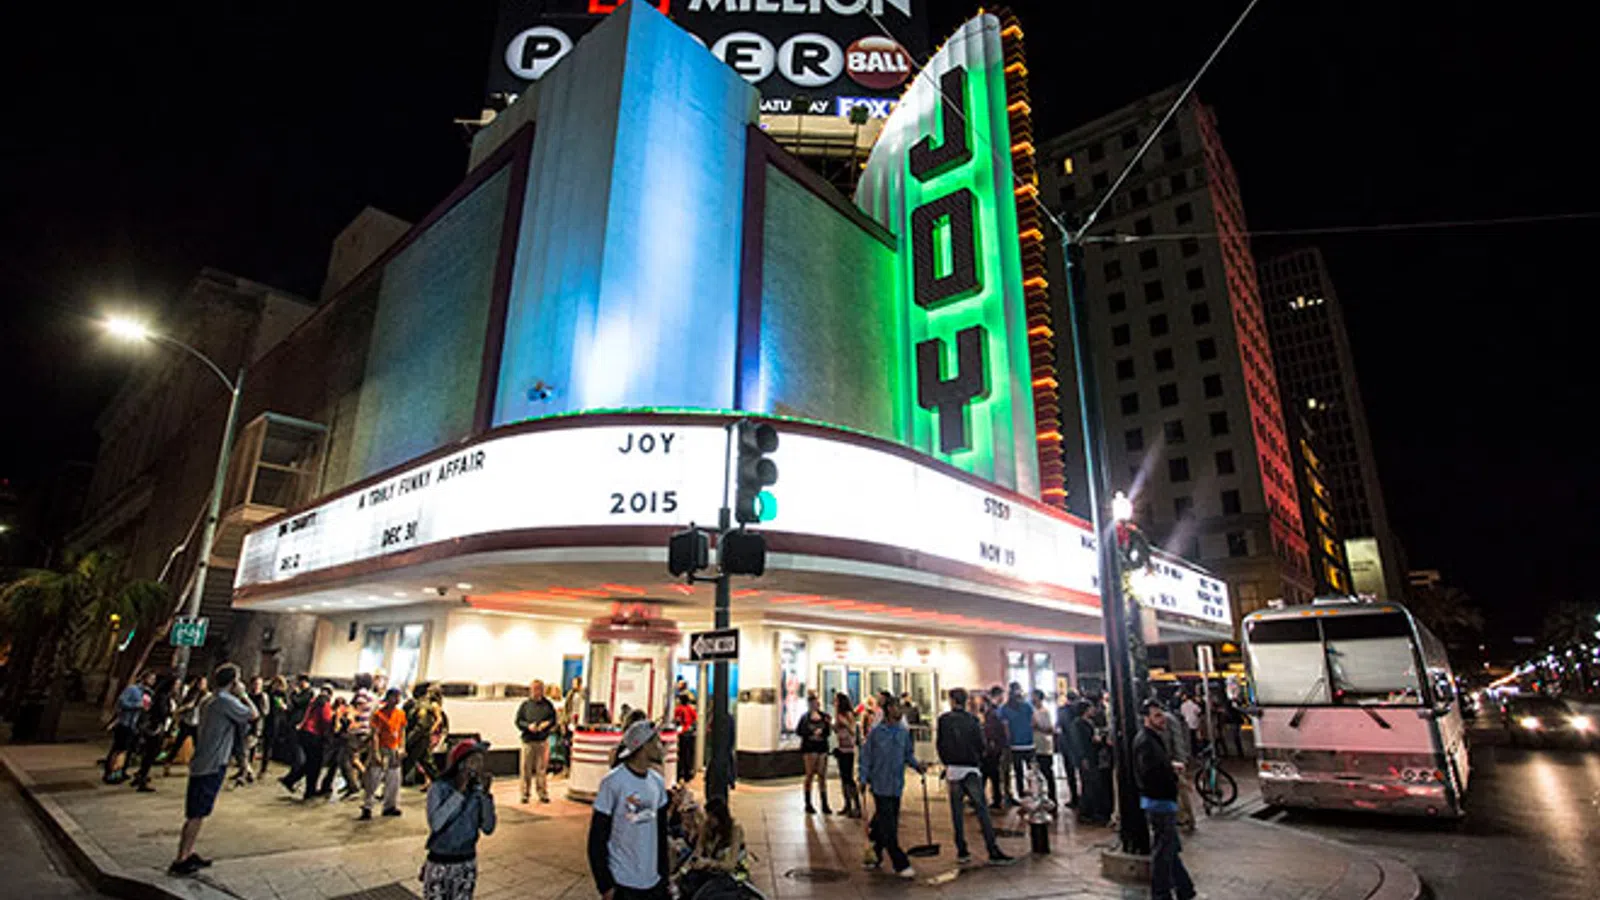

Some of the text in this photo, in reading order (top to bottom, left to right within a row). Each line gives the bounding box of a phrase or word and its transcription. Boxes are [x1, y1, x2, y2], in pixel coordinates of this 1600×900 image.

[848, 52, 909, 73] BALL
[909, 65, 992, 454] JOY
[618, 432, 676, 454] JOY
[437, 449, 486, 482] AFFAIR
[610, 490, 678, 514] 2015
